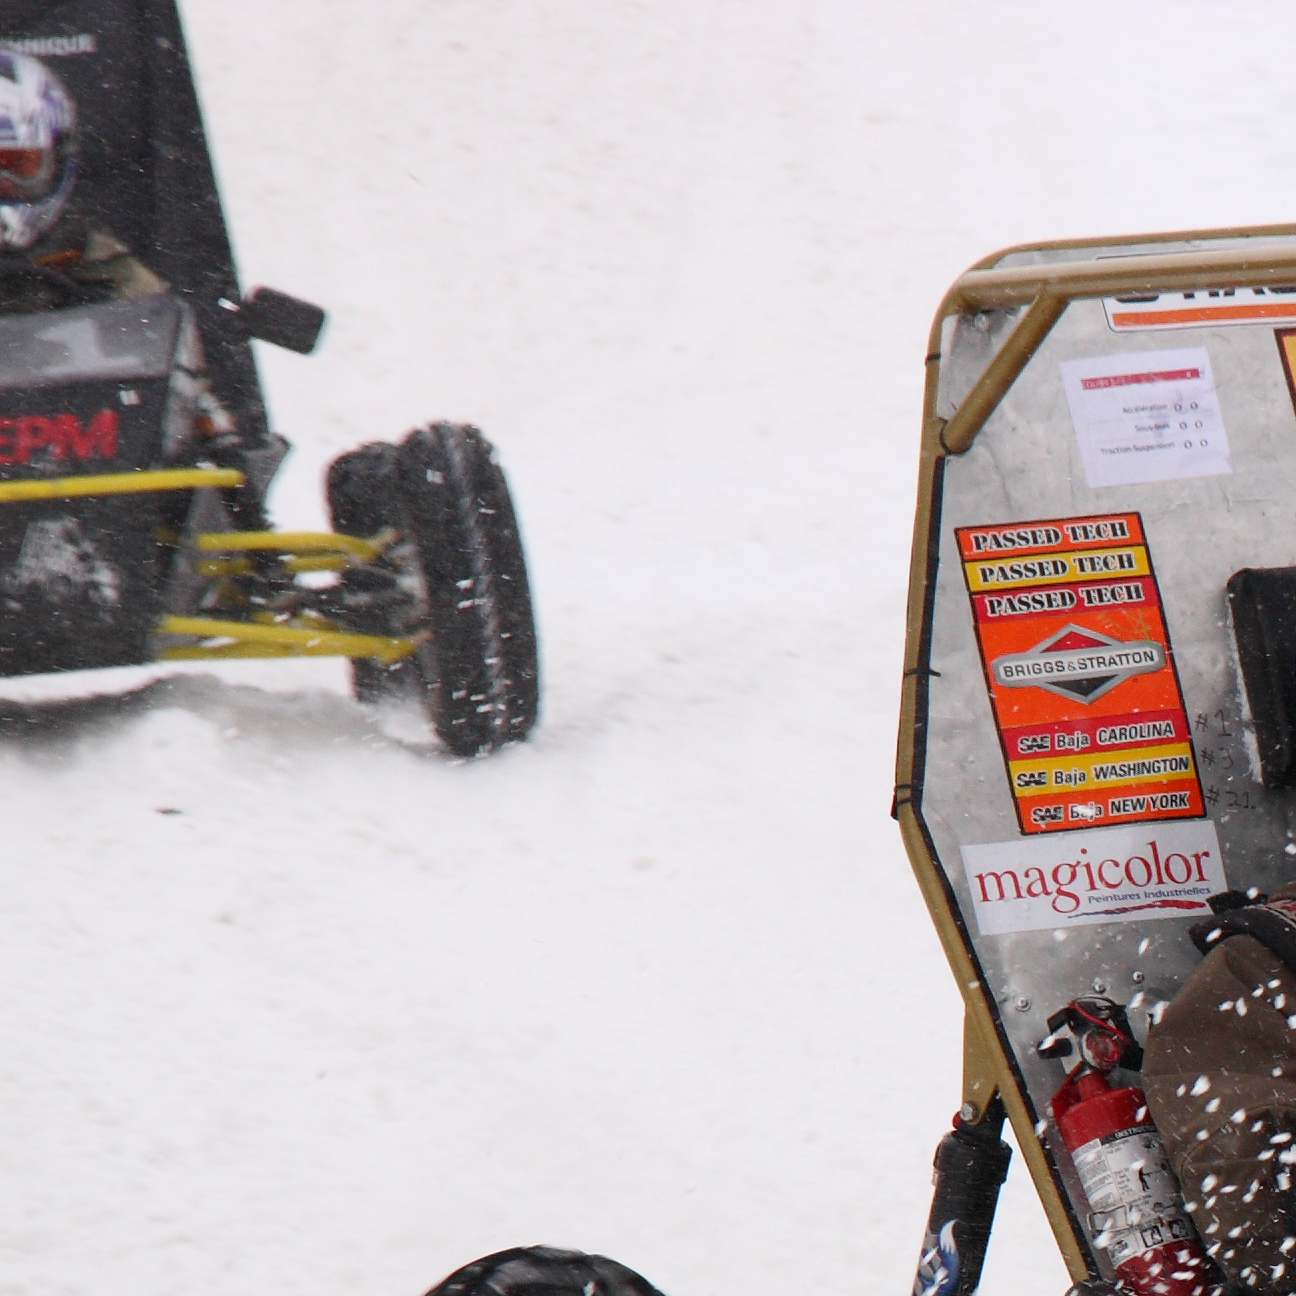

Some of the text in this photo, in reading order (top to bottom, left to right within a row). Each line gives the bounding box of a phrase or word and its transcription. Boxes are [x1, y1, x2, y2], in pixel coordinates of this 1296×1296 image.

[972, 521, 1128, 551] PASSED TECH
[980, 553, 1135, 584] PASSED TECH
[987, 583, 1144, 616] PASSED TECH
[1019, 721, 1174, 753] SAE Baja CAROLINA
[1017, 756, 1189, 788] SAE Baja WASHINGTON
[1032, 806, 1064, 823] SAE
[1110, 795, 1147, 815] NEW
[1150, 792, 1188, 810] YORK
[974, 841, 1210, 914] magicolor
[1087, 887, 1211, 904] Peintures Industrielles
